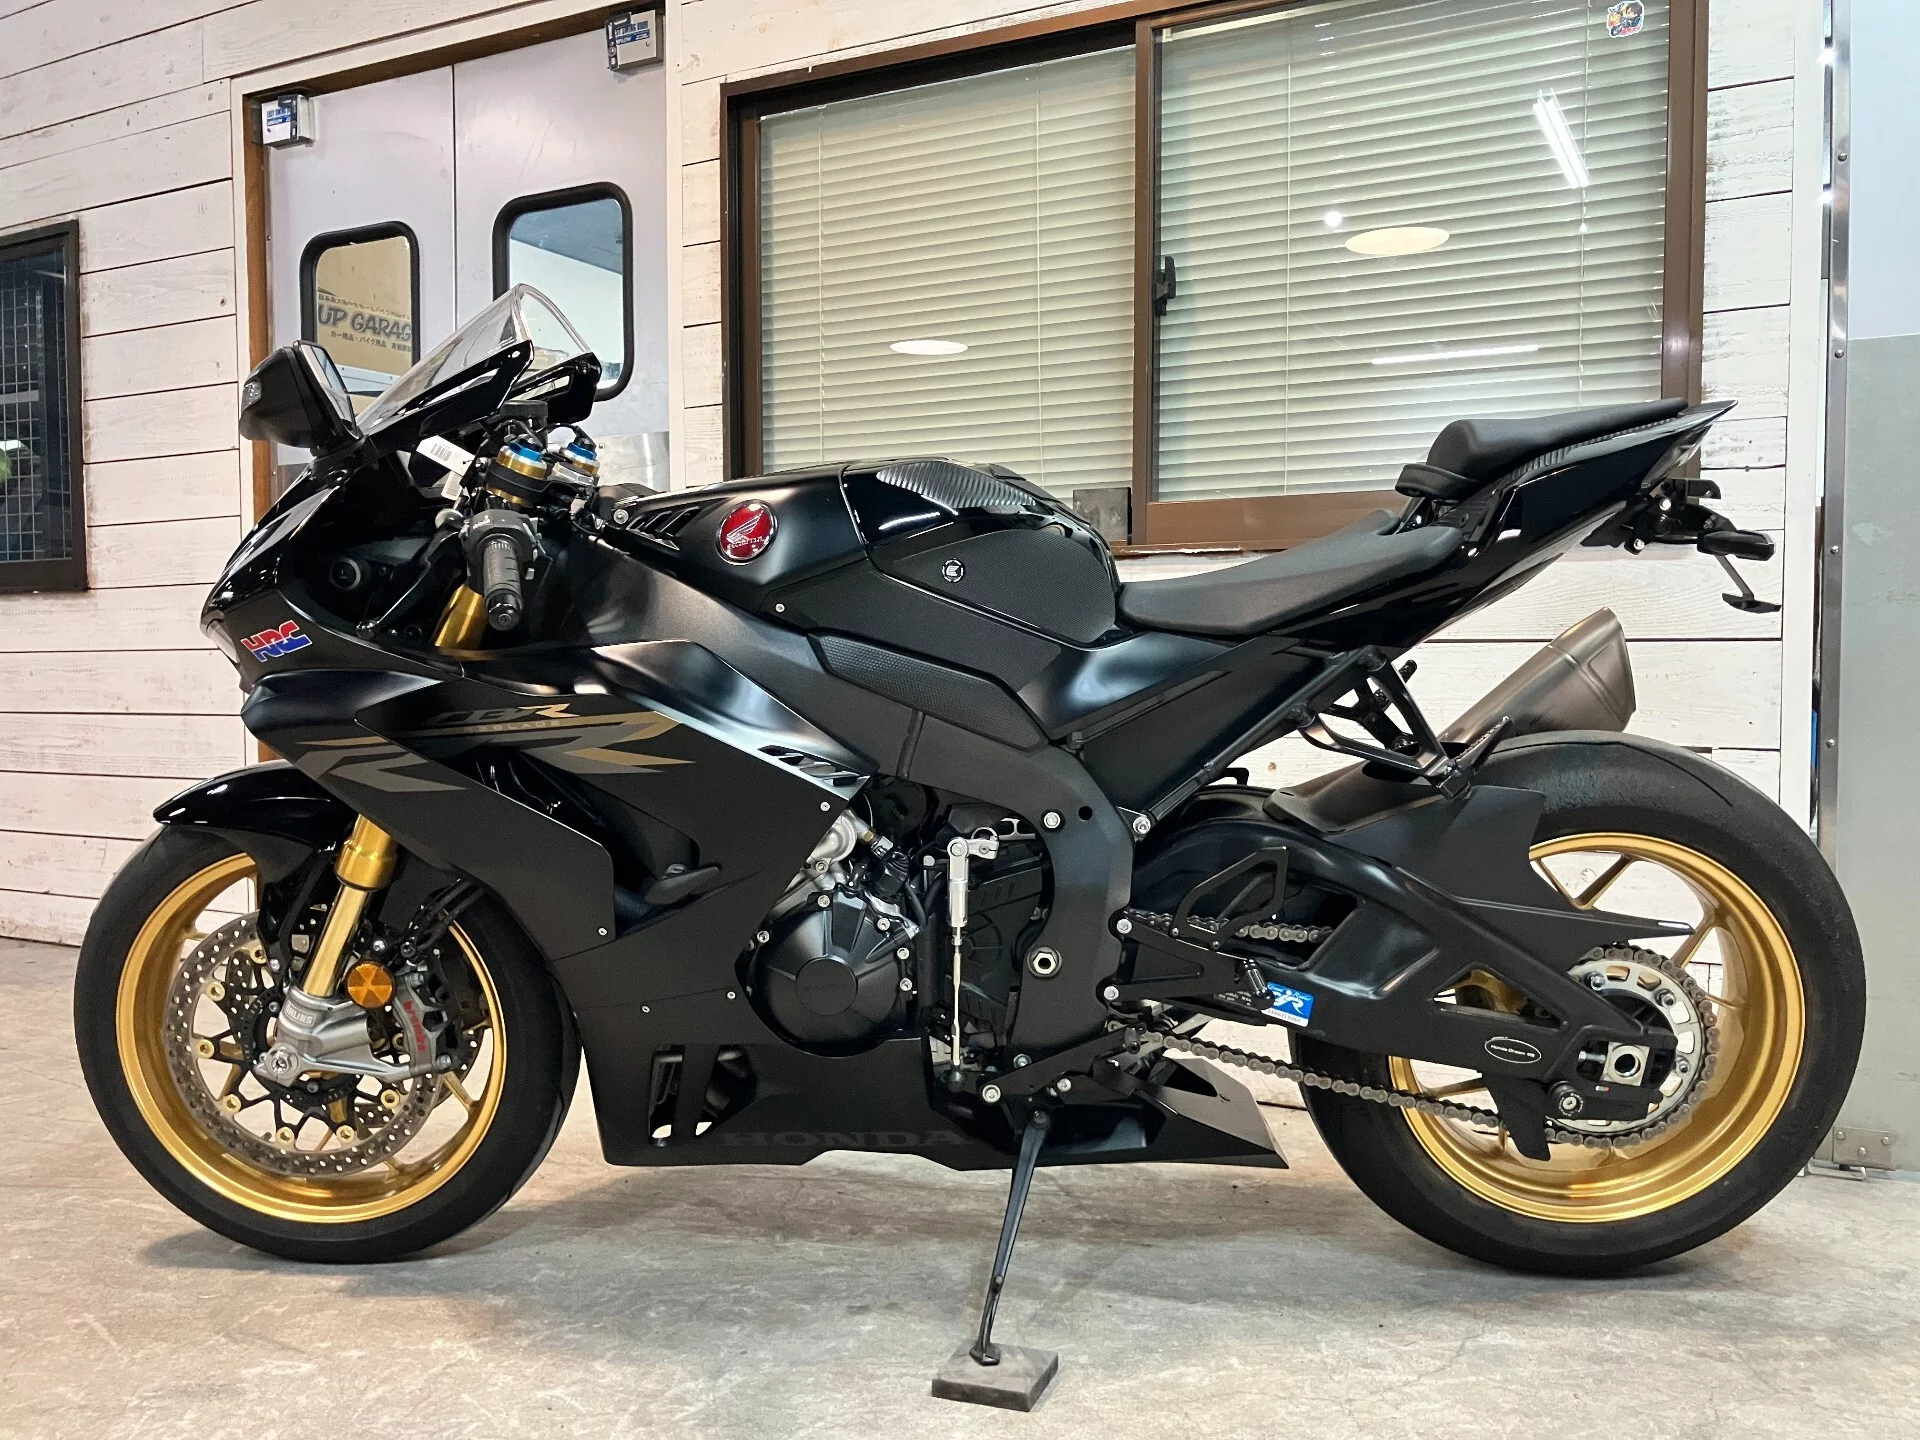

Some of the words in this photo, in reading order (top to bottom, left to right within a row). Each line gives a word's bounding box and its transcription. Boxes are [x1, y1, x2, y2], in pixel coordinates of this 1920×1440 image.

[317, 304, 347, 326] UP
[240, 620, 313, 662] HRC
[719, 1131, 974, 1147] HONDA
